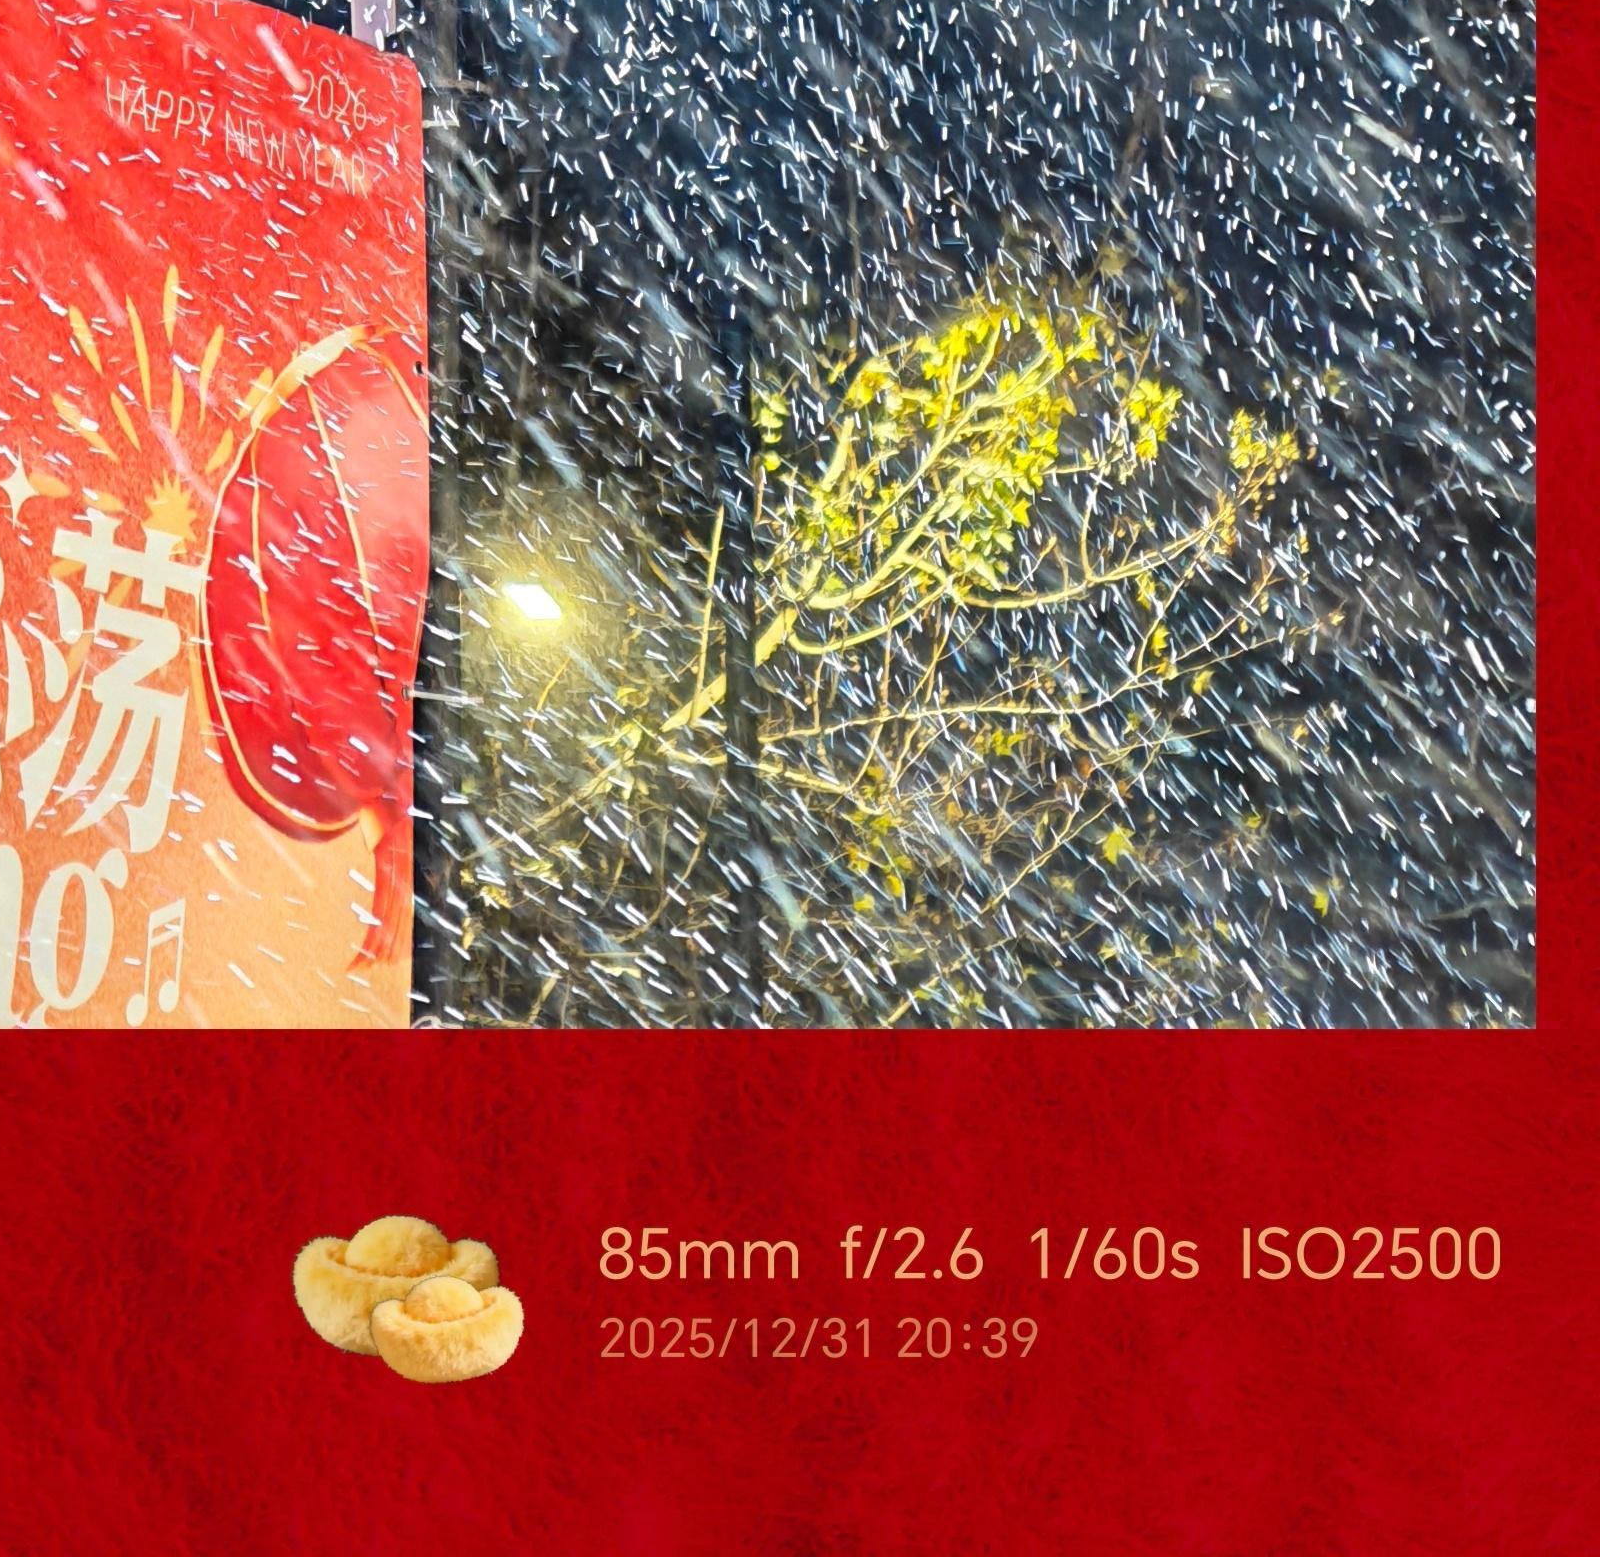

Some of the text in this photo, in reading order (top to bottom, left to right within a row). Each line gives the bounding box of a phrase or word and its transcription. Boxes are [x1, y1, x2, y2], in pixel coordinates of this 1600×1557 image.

[104, 75, 370, 198] HAPPY NEW YEAR
[298, 68, 367, 132] 2026
